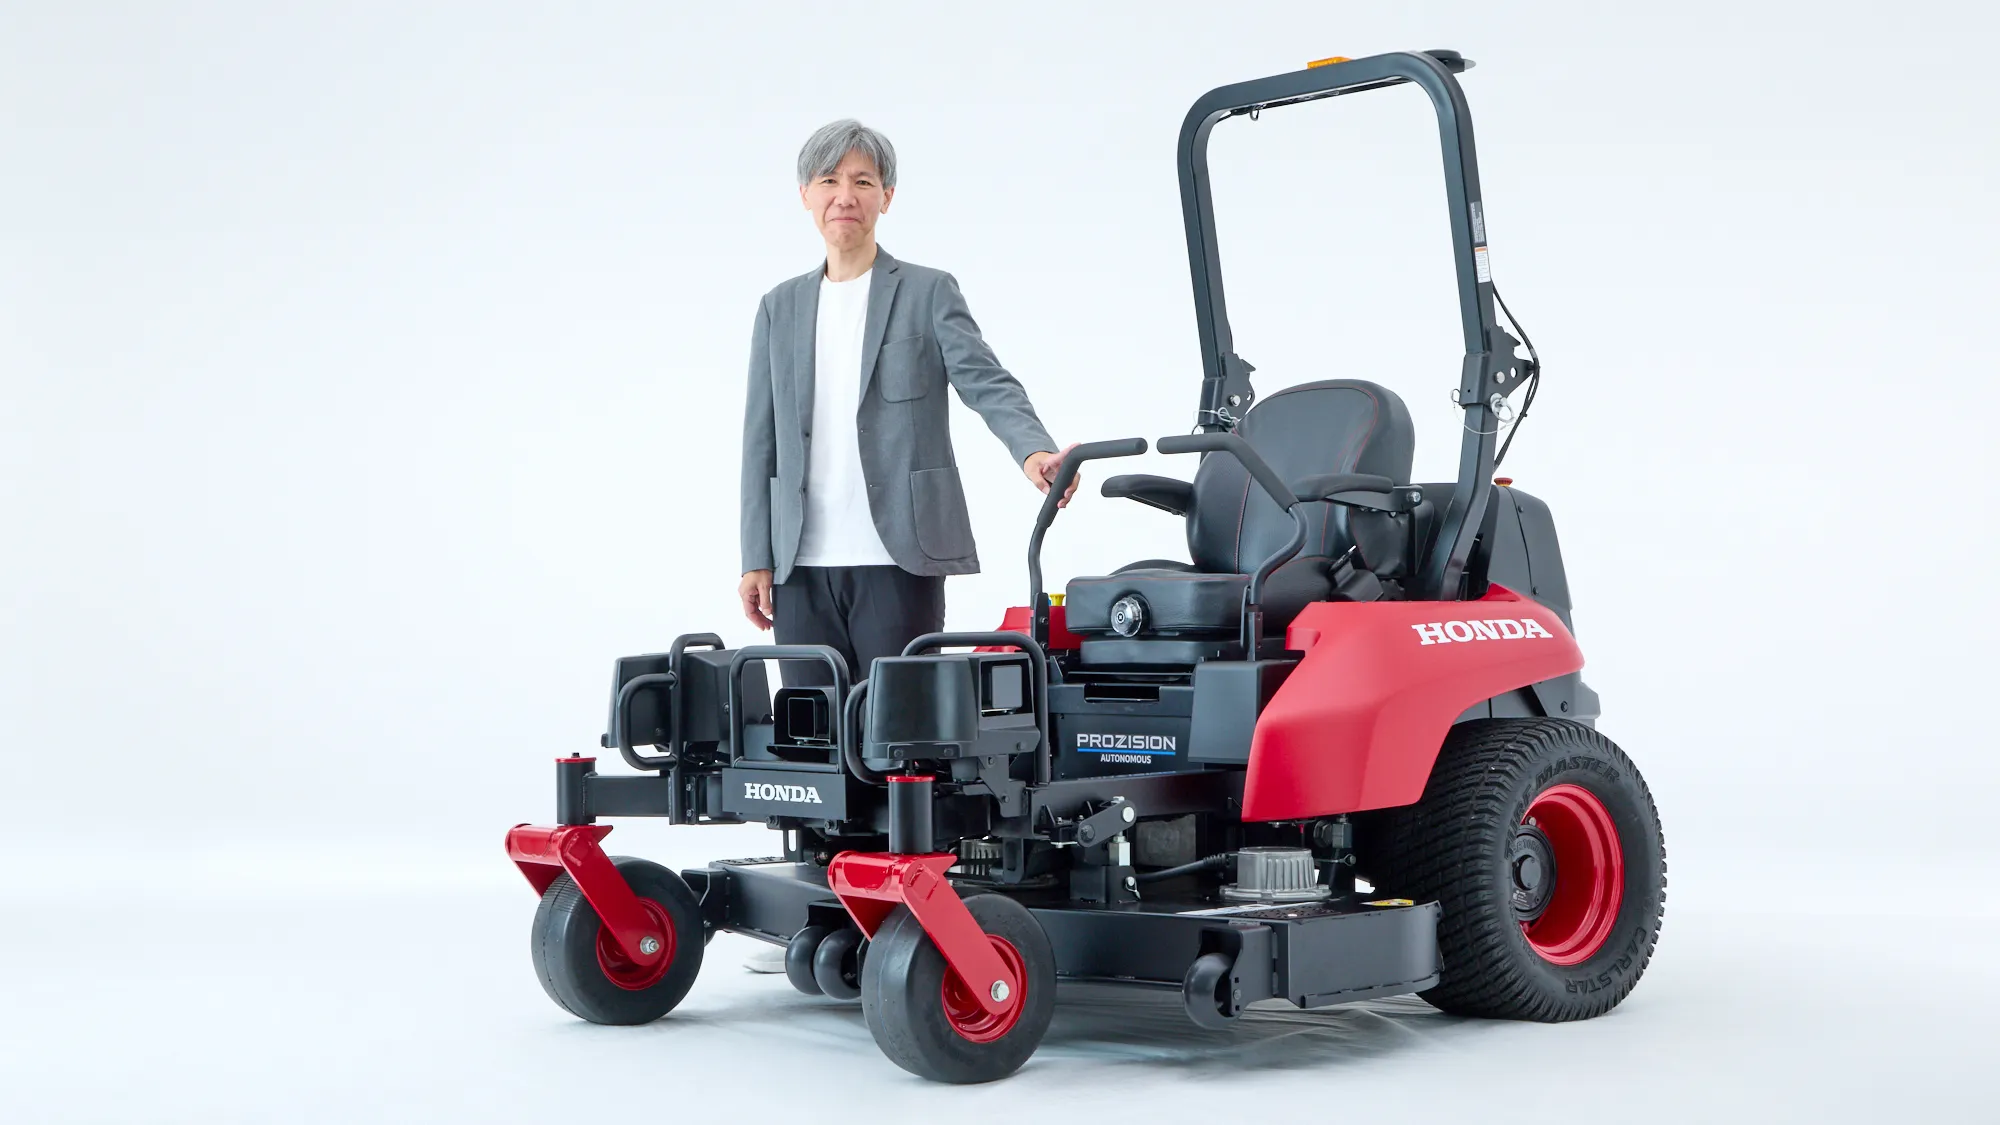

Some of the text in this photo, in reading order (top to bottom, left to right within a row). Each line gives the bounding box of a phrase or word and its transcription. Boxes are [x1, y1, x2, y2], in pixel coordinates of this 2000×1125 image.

[1412, 619, 1553, 645] HONDA
[1077, 733, 1176, 751] PROZISION
[1100, 753, 1152, 764] AUTONOMOUS
[1535, 755, 1620, 788] MASTER
[744, 782, 822, 803] HONDA
[1565, 926, 1647, 994] CARLSTAR
